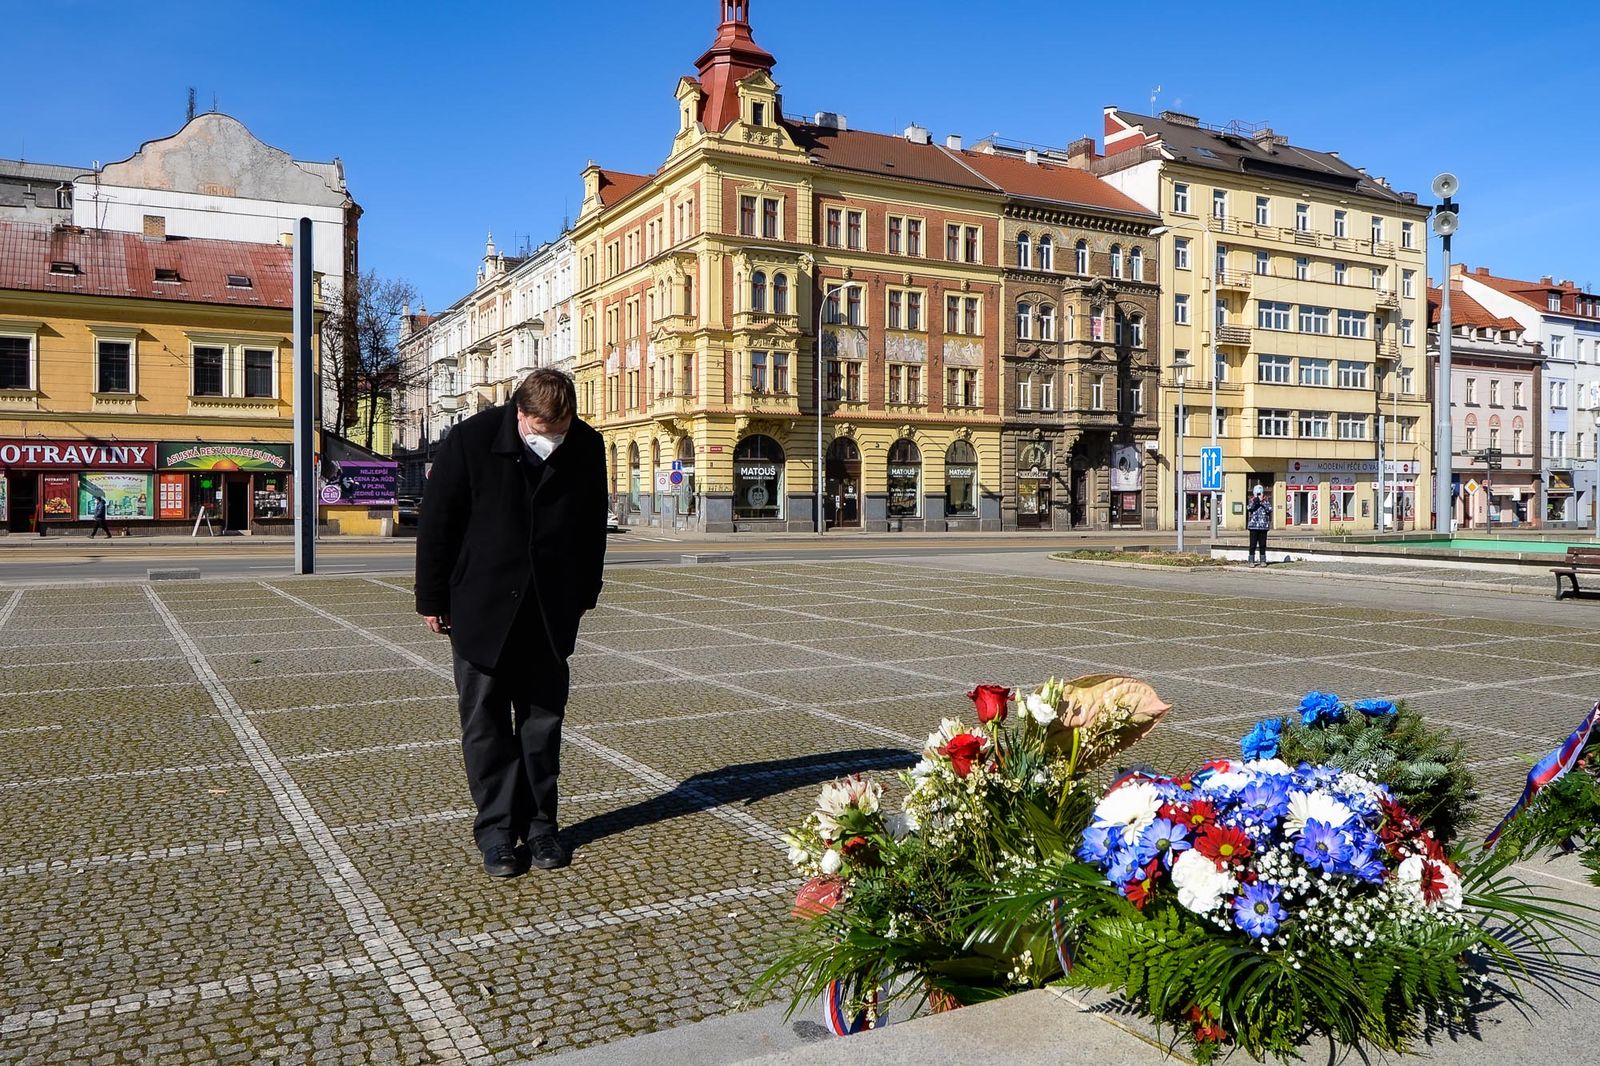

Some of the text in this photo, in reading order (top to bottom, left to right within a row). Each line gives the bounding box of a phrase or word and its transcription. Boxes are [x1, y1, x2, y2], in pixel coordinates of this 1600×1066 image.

[166, 446, 286, 468] ASIJSKÁ RESTAURACE SLUNCE
[740, 465, 776, 476] MATOUŠ
[891, 467, 915, 475] MATOUŠ
[1317, 461, 1346, 471] MODERNÍ
